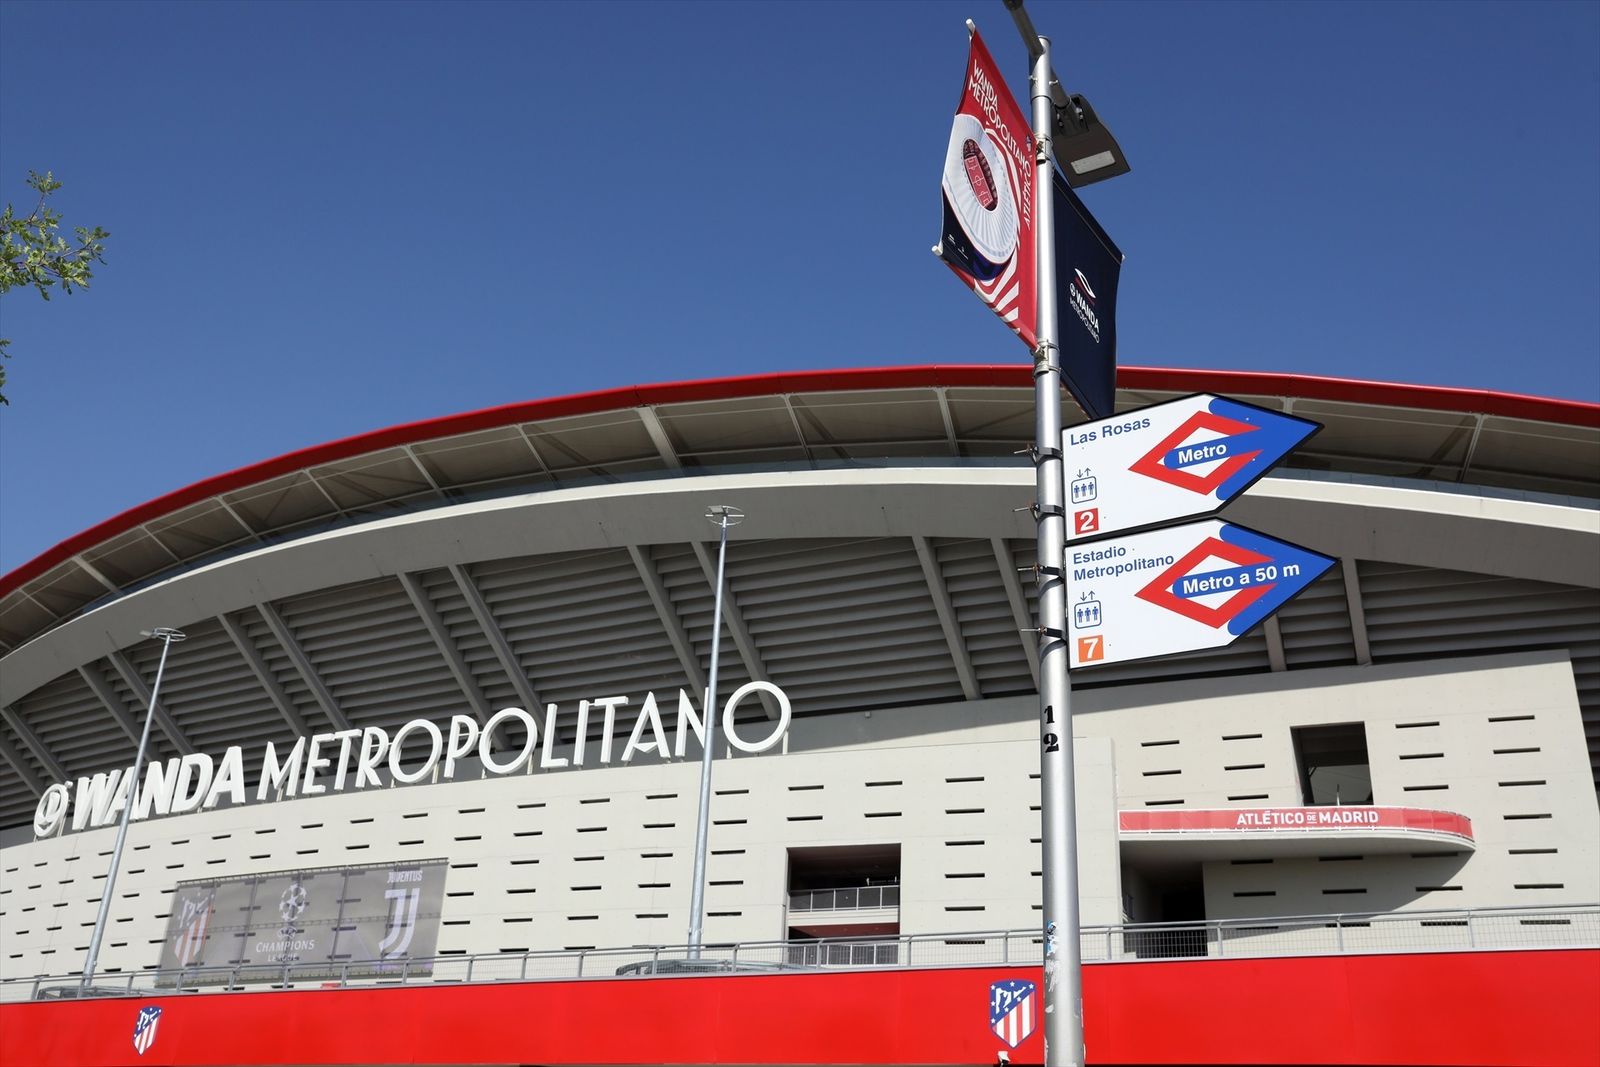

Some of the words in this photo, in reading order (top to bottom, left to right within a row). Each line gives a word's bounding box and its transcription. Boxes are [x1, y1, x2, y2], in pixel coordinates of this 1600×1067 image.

[973, 58, 999, 111] WANDA
[968, 75, 1032, 176] METROPOLITANO
[1076, 289, 1100, 334] WANDA
[1070, 431, 1097, 446] Las
[1102, 418, 1151, 438] Rosas
[1178, 444, 1227, 464] Metro
[1080, 511, 1095, 532] 2
[1073, 546, 1127, 565] Estadio
[1073, 554, 1175, 581] Metropolitano
[1183, 574, 1234, 594] Metro
[1239, 573, 1251, 585] a
[1255, 565, 1278, 583] 50
[1283, 563, 1300, 578] m
[1083, 637, 1099, 659] 7
[72, 745, 246, 831] WANDA
[256, 681, 792, 801] METROPOLITANO
[1236, 810, 1304, 825] ATLÉTICO
[1306, 812, 1317, 822] DE
[1319, 811, 1379, 824] MADRID
[387, 870, 423, 884] JUVENTUS
[255, 940, 315, 953] CHAMPIONS
